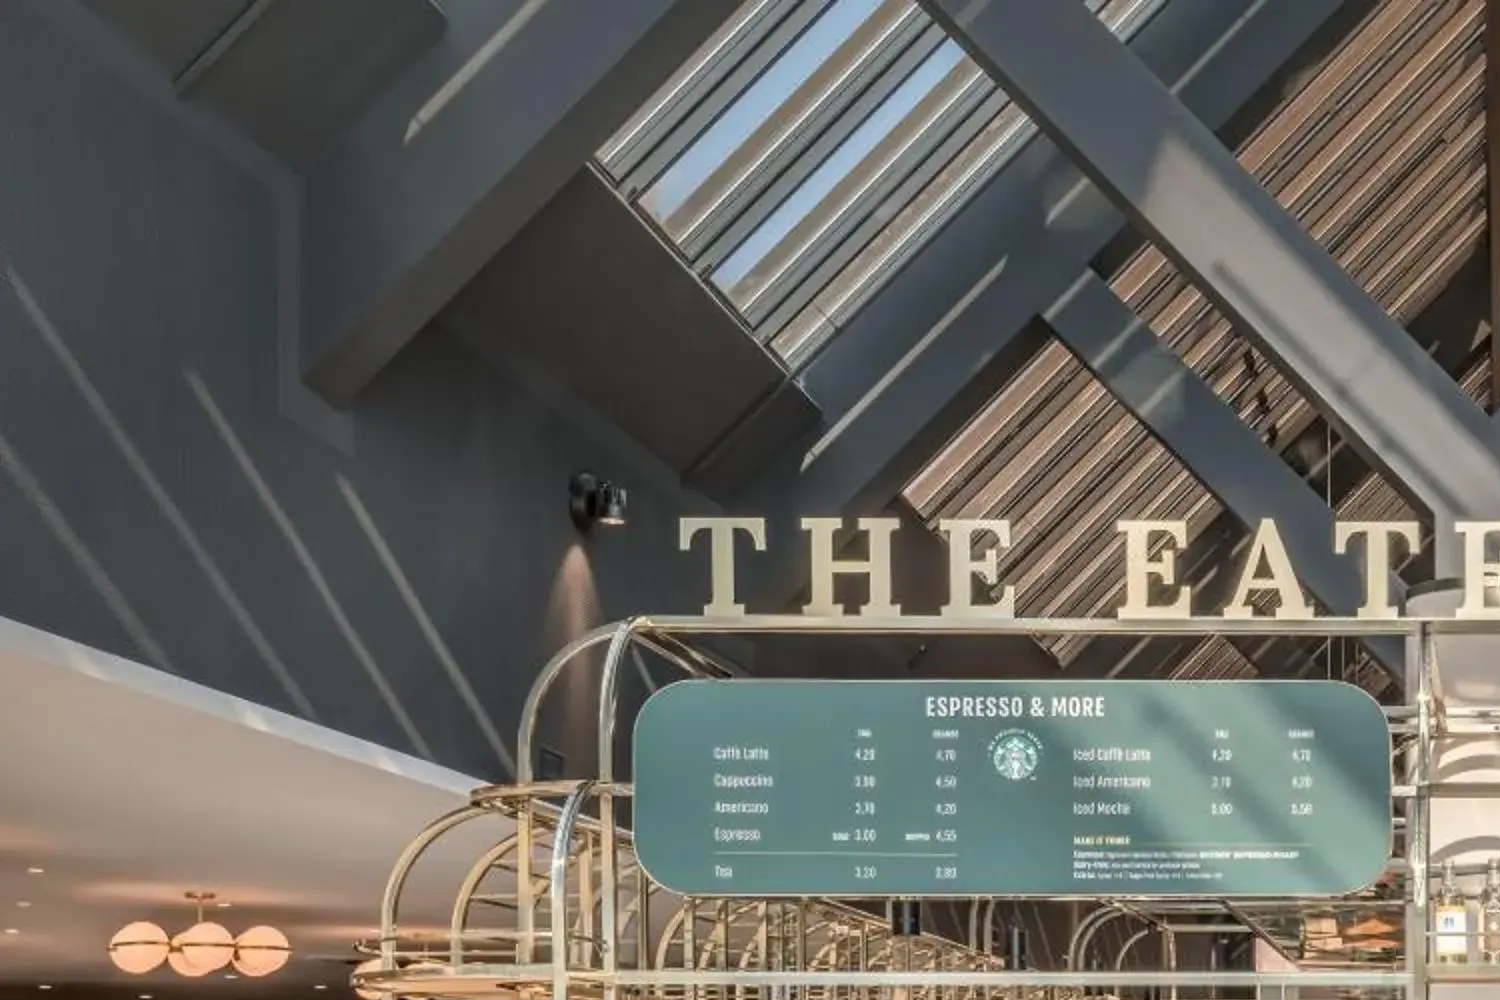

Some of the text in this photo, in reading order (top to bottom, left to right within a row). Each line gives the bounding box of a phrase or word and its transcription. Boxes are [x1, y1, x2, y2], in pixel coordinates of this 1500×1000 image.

[679, 517, 1016, 617] THE
[926, 695, 1105, 717] ESPRESSO & MORE
[1073, 748, 1095, 761] Iced
[713, 773, 774, 789] Cappuccino
[1073, 775, 1095, 789] Iced
[1097, 775, 1151, 789] Americano
[714, 801, 769, 814] Americano
[1073, 802, 1095, 816] Iced
[1097, 802, 1131, 816] Mocha
[714, 826, 761, 842] Espresso
